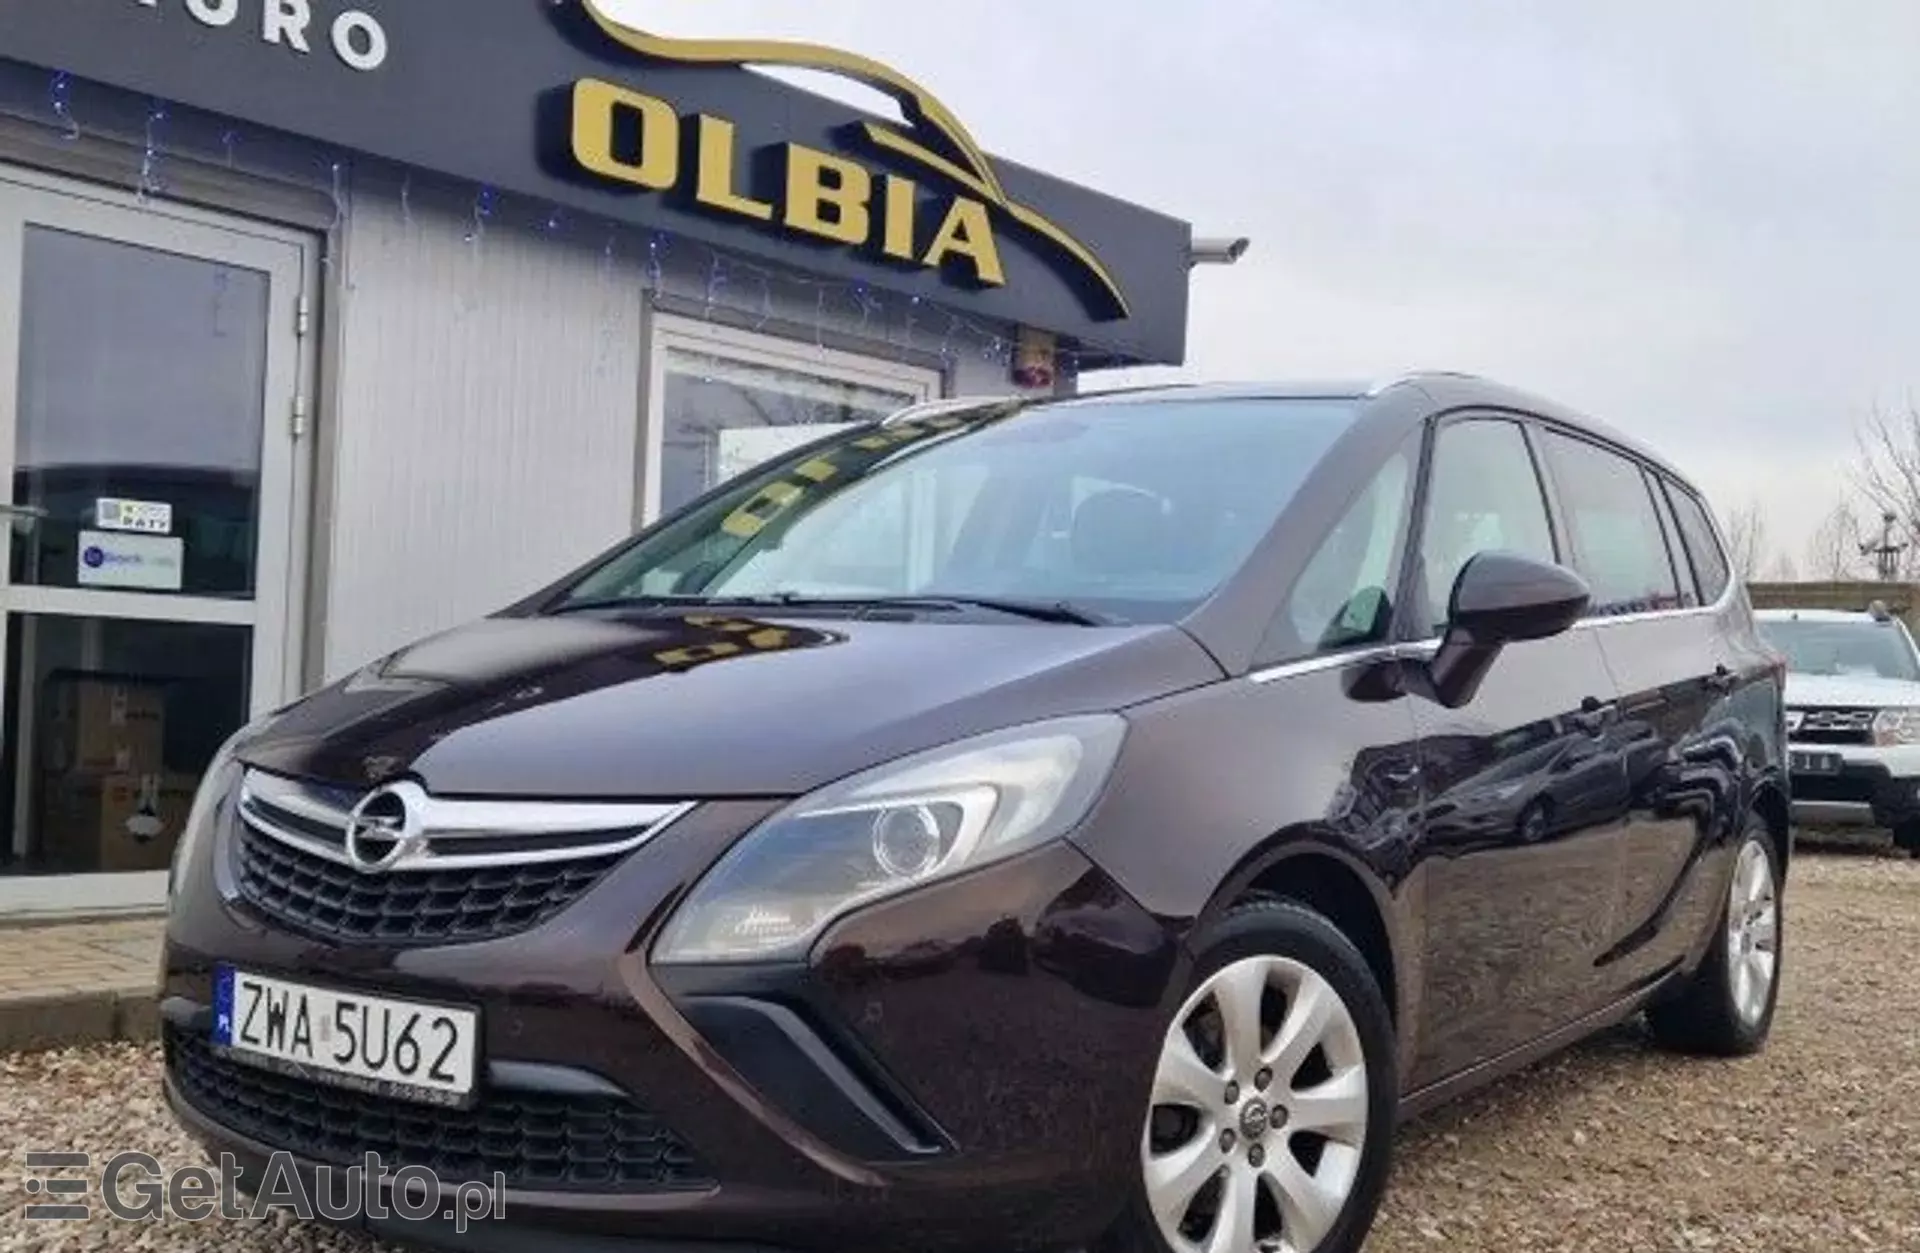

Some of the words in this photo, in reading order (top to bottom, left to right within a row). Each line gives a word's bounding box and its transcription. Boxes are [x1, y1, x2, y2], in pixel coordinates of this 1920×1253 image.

[572, 78, 1006, 286] OLBIA
[240, 981, 313, 1058] ZWA
[334, 1000, 458, 1083] 5U62
